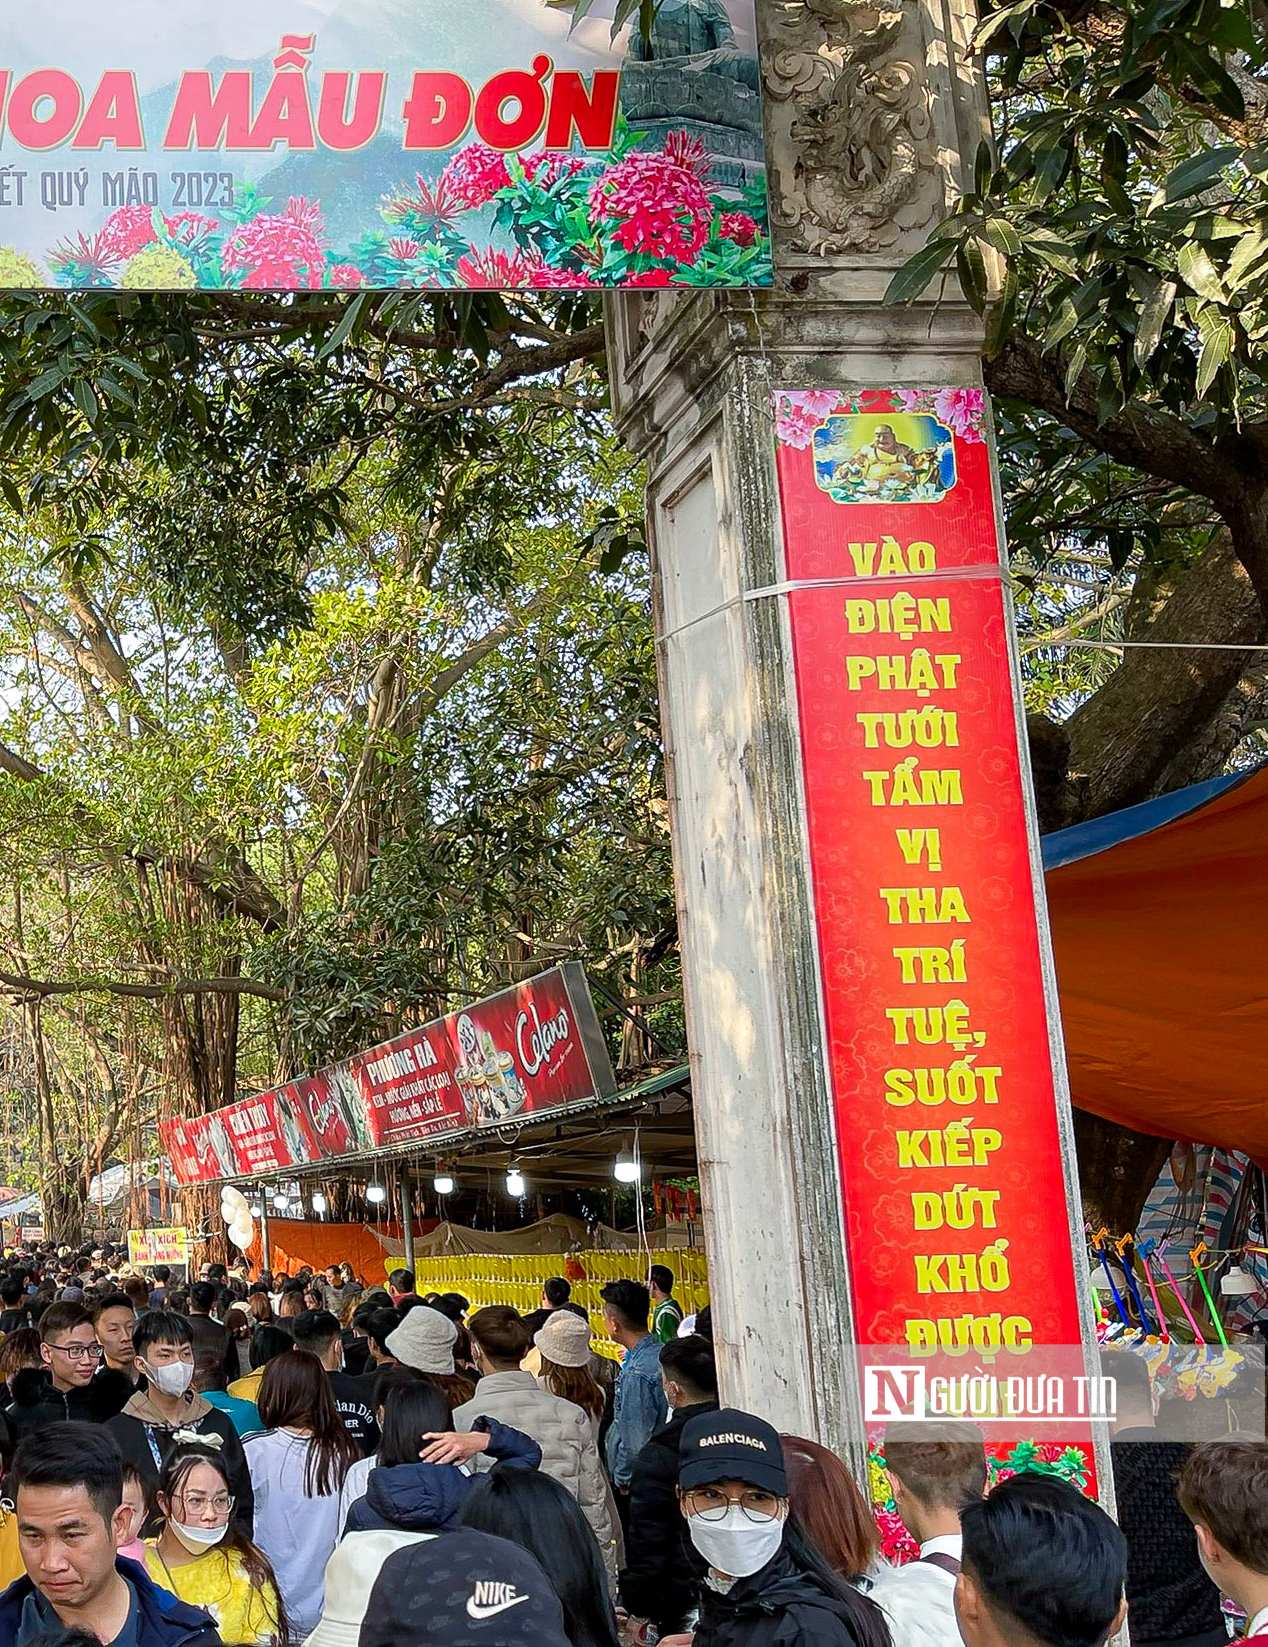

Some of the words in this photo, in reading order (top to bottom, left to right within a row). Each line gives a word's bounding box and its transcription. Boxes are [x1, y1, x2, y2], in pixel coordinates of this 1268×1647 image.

[163, 33, 386, 152] MẪU
[403, 54, 622, 153] ĐƠN
[40, 167, 89, 212] QUÝ
[102, 167, 159, 206] MÃO
[171, 171, 234, 206] 2023
[847, 535, 937, 577] VÀO
[844, 591, 953, 640] ĐIỆN
[845, 647, 962, 698] PHẬT
[857, 705, 960, 749] TƯỚI
[862, 756, 964, 807] TẨM
[895, 828, 942, 872] VỊ
[879, 886, 972, 925] THA
[892, 938, 968, 984] TRÍ
[516, 1002, 569, 1077] Celano
[884, 998, 987, 1052] TUỆ,
[413, 1036, 438, 1069] HÀ
[883, 1054, 1003, 1107] SUỐT
[895, 1117, 1003, 1169] KIẾP
[911, 1183, 1001, 1231] DỨT
[914, 1237, 1011, 1294] KHỔ
[904, 1312, 1034, 1364] ĐƯỢC
[699, 1432, 768, 1452] BALENCIAGA
[474, 1580, 516, 1605] NIKE
